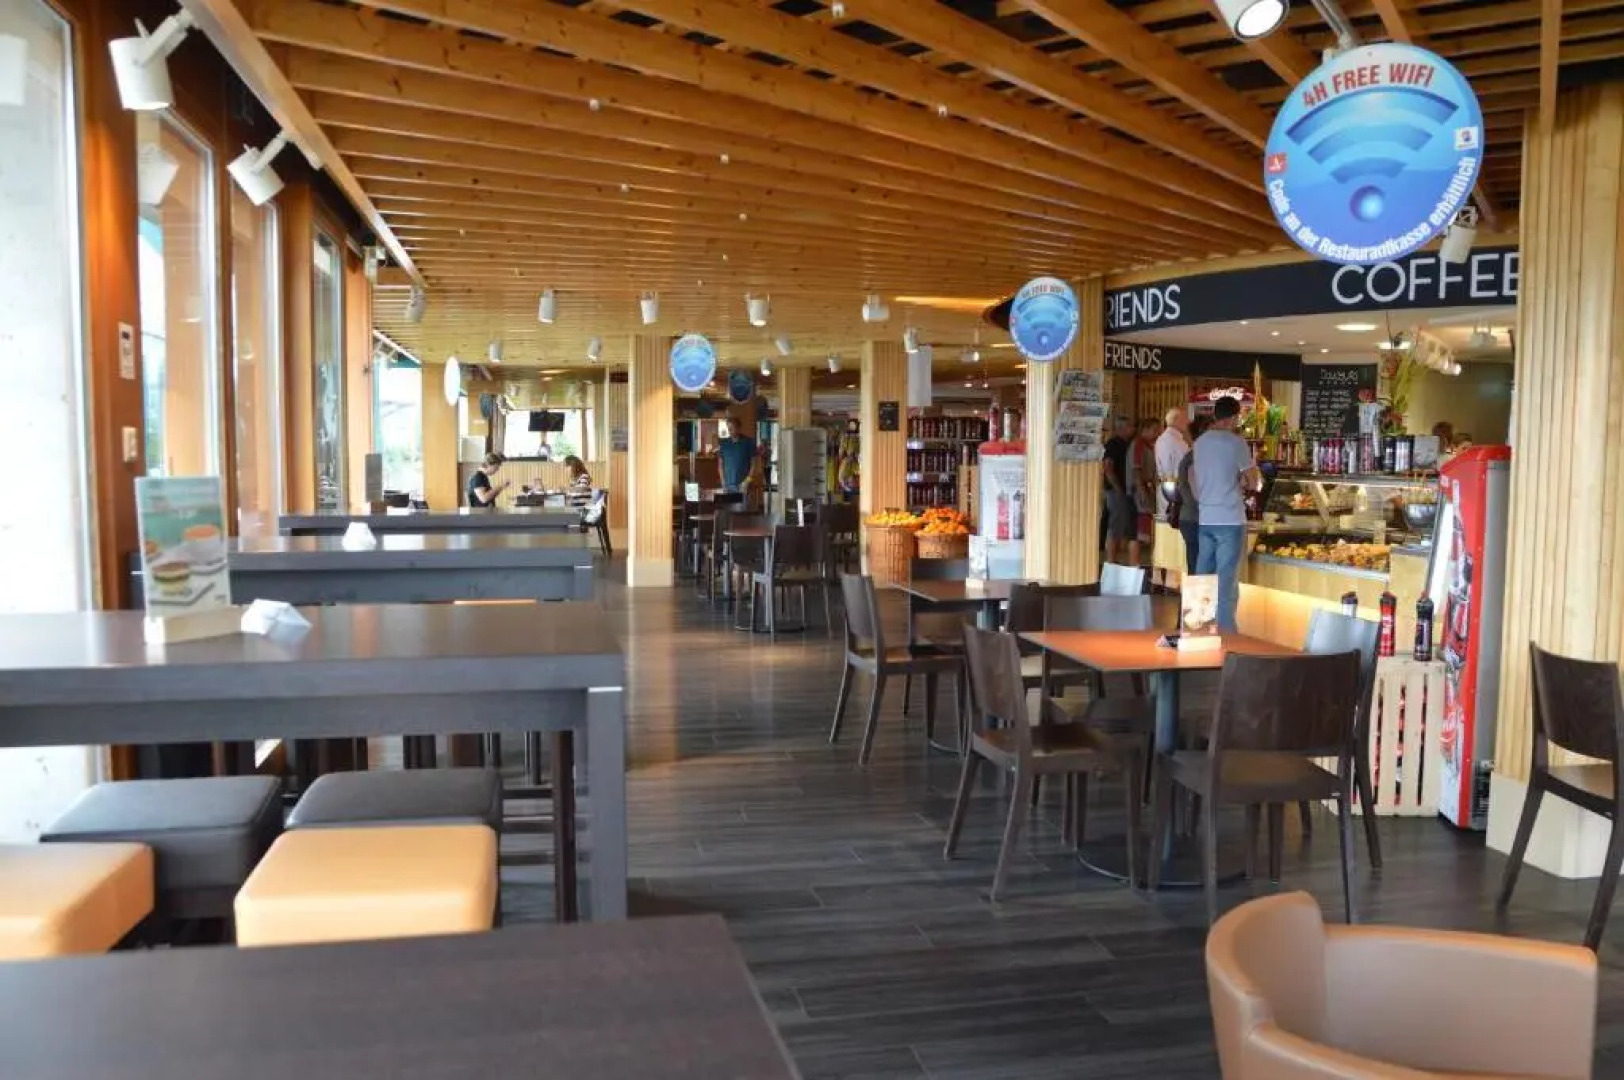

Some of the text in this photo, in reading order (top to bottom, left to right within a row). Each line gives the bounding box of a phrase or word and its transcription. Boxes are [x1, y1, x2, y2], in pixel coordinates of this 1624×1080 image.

[1303, 63, 1434, 107] 4H FREE WIFI
[1318, 222, 1431, 260] Restaurantkasse
[1332, 252, 1518, 304] COFFEE
[1105, 342, 1162, 371] FRIENDS
